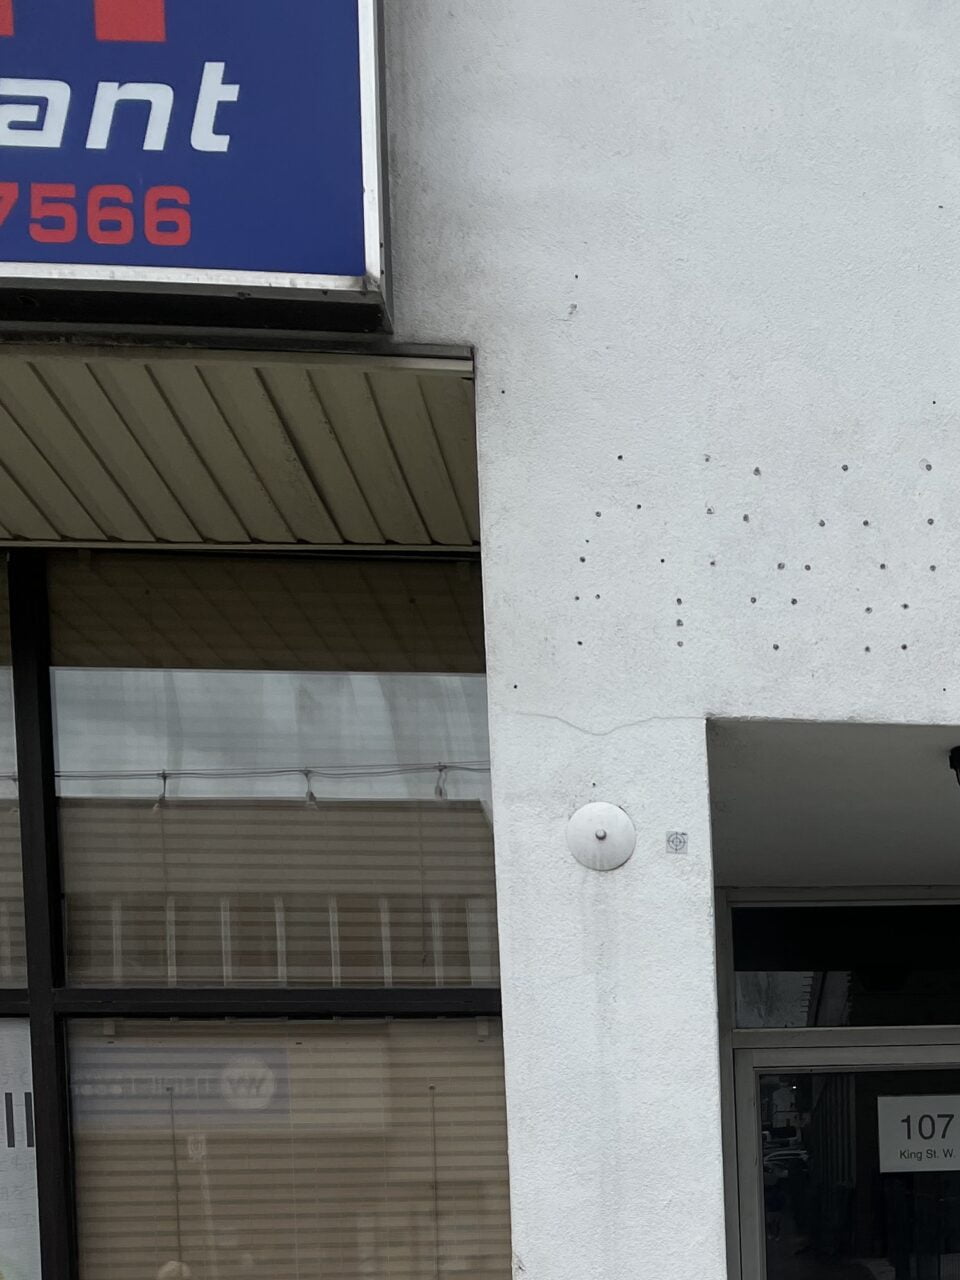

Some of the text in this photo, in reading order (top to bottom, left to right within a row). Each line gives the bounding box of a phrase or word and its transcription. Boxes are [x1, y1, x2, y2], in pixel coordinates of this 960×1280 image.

[901, 1114, 954, 1140] 107
[900, 1149, 922, 1161] King
[926, 1148, 940, 1159] St.
